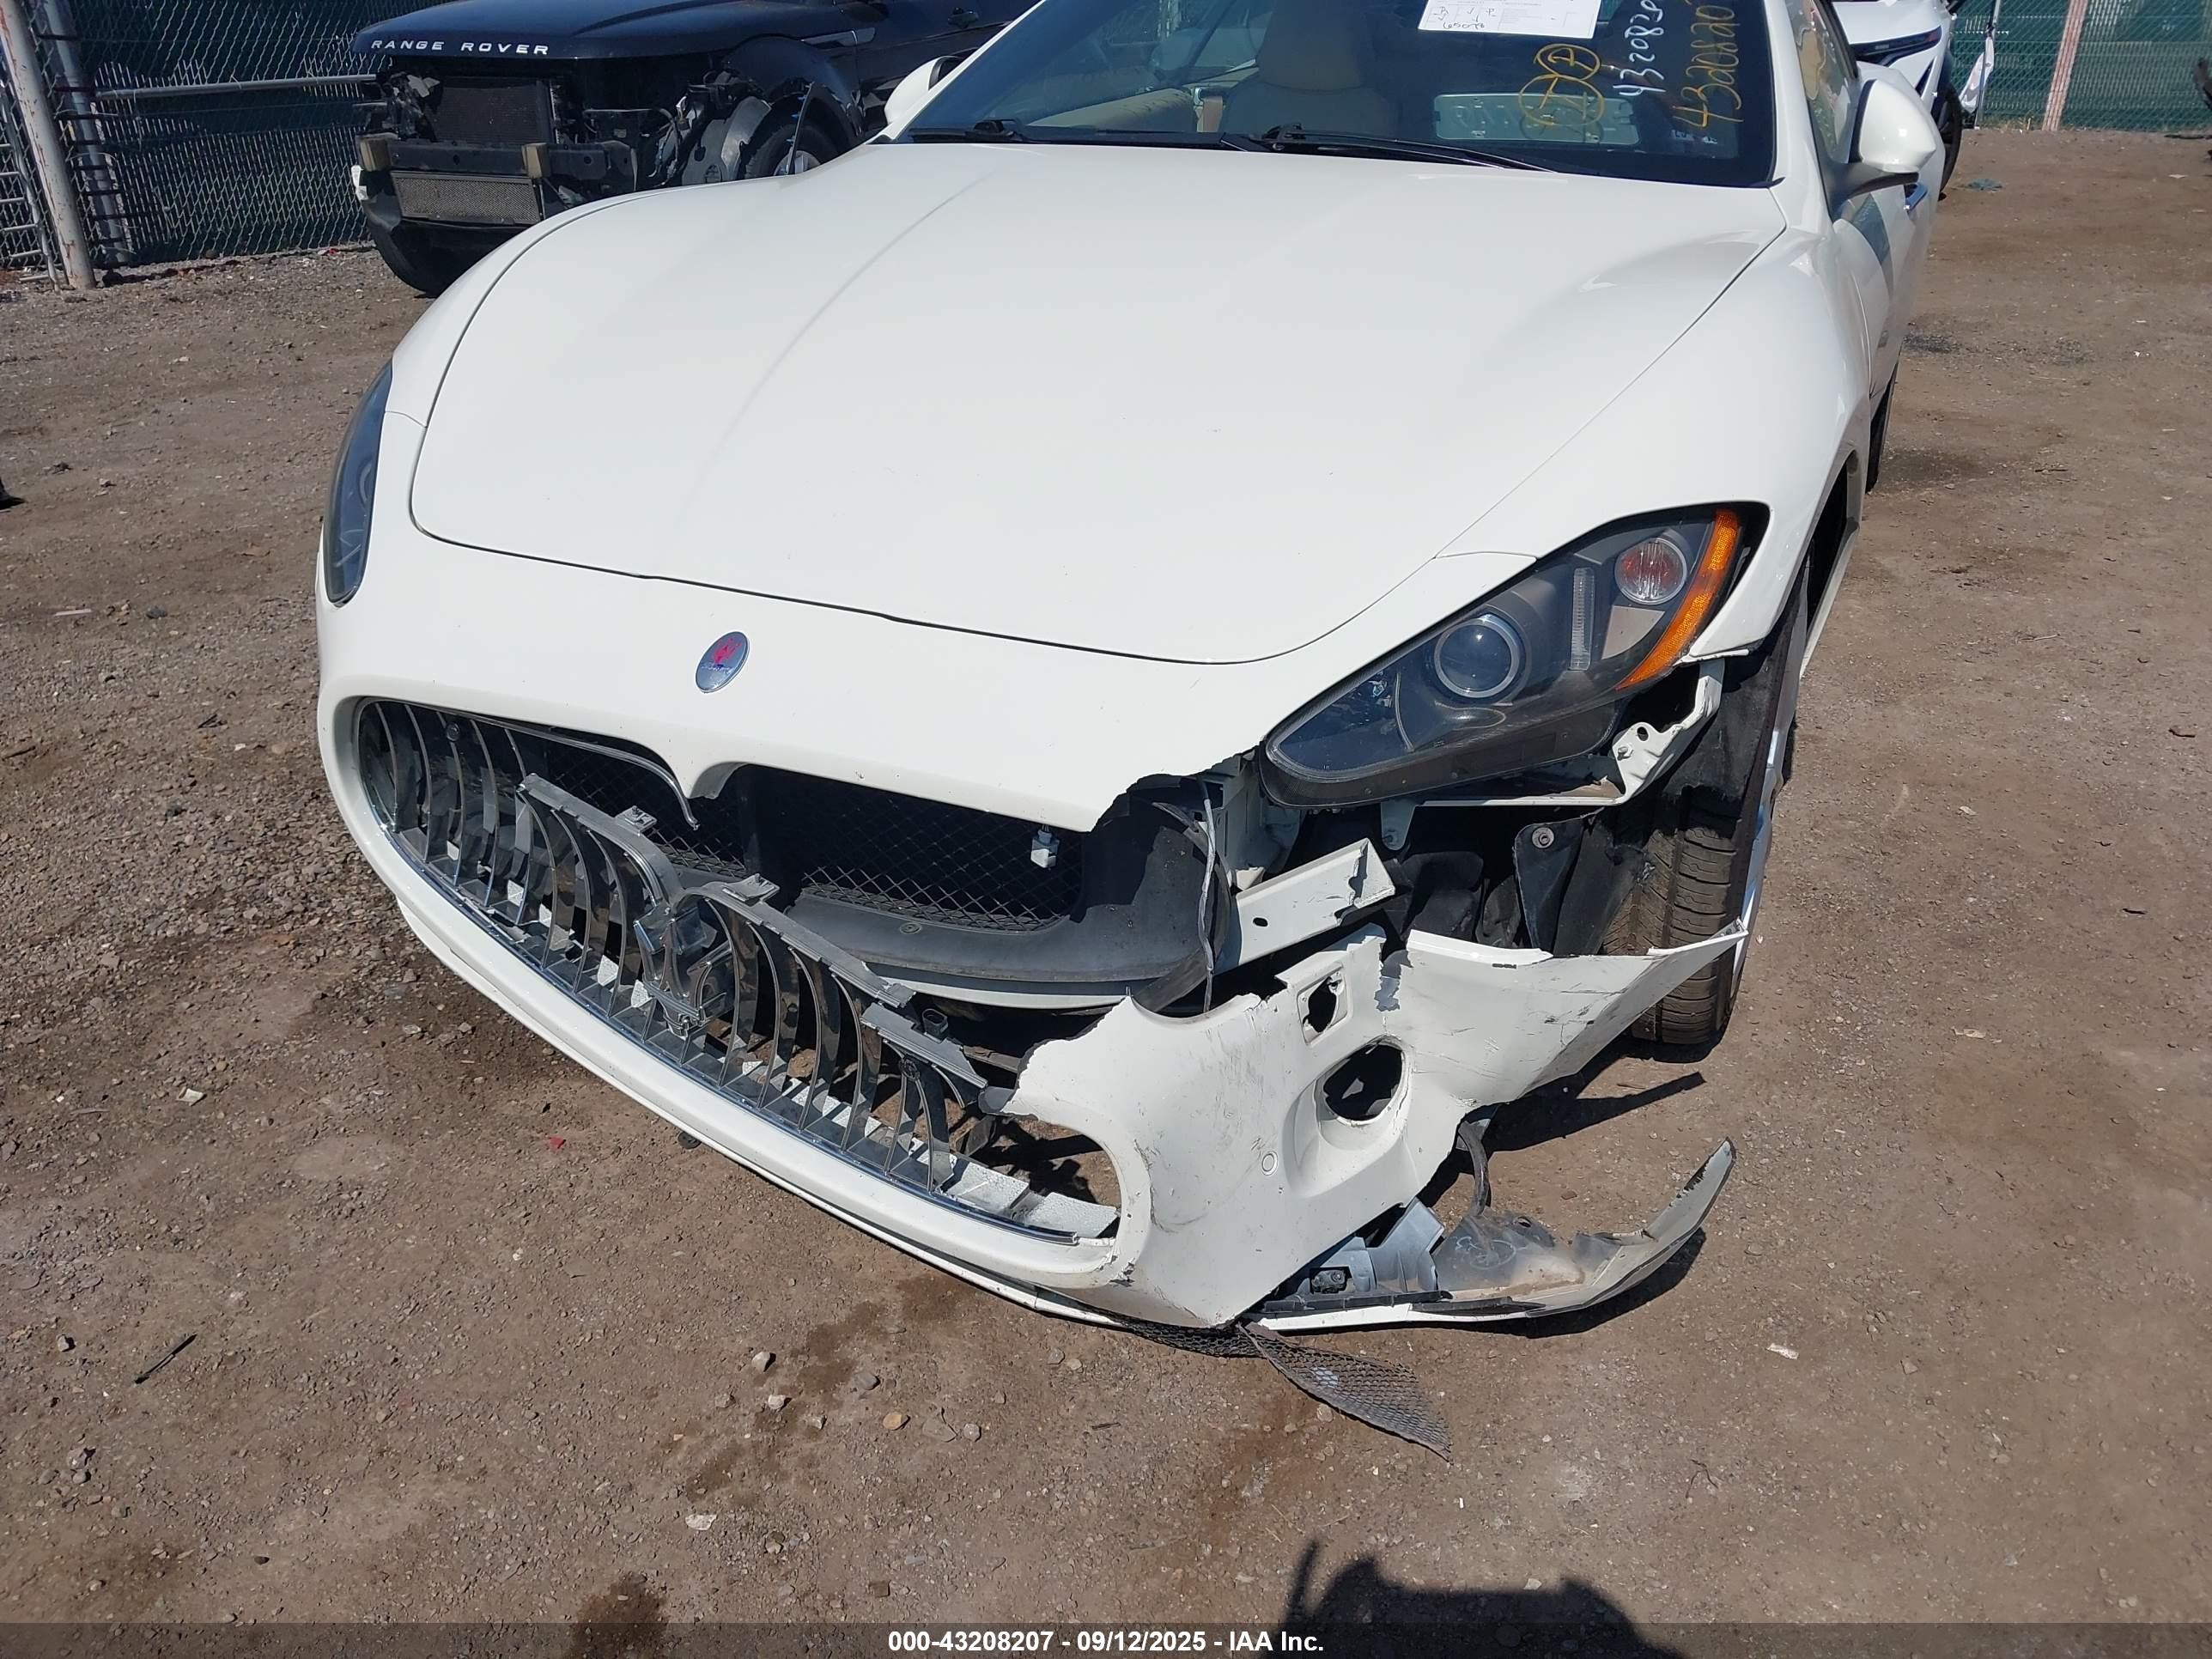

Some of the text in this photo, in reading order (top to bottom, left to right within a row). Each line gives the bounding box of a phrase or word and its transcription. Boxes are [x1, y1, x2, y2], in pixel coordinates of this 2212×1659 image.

[371, 40, 549, 55] RANGE ROVER
[1672, 0, 1744, 127] 4320820
